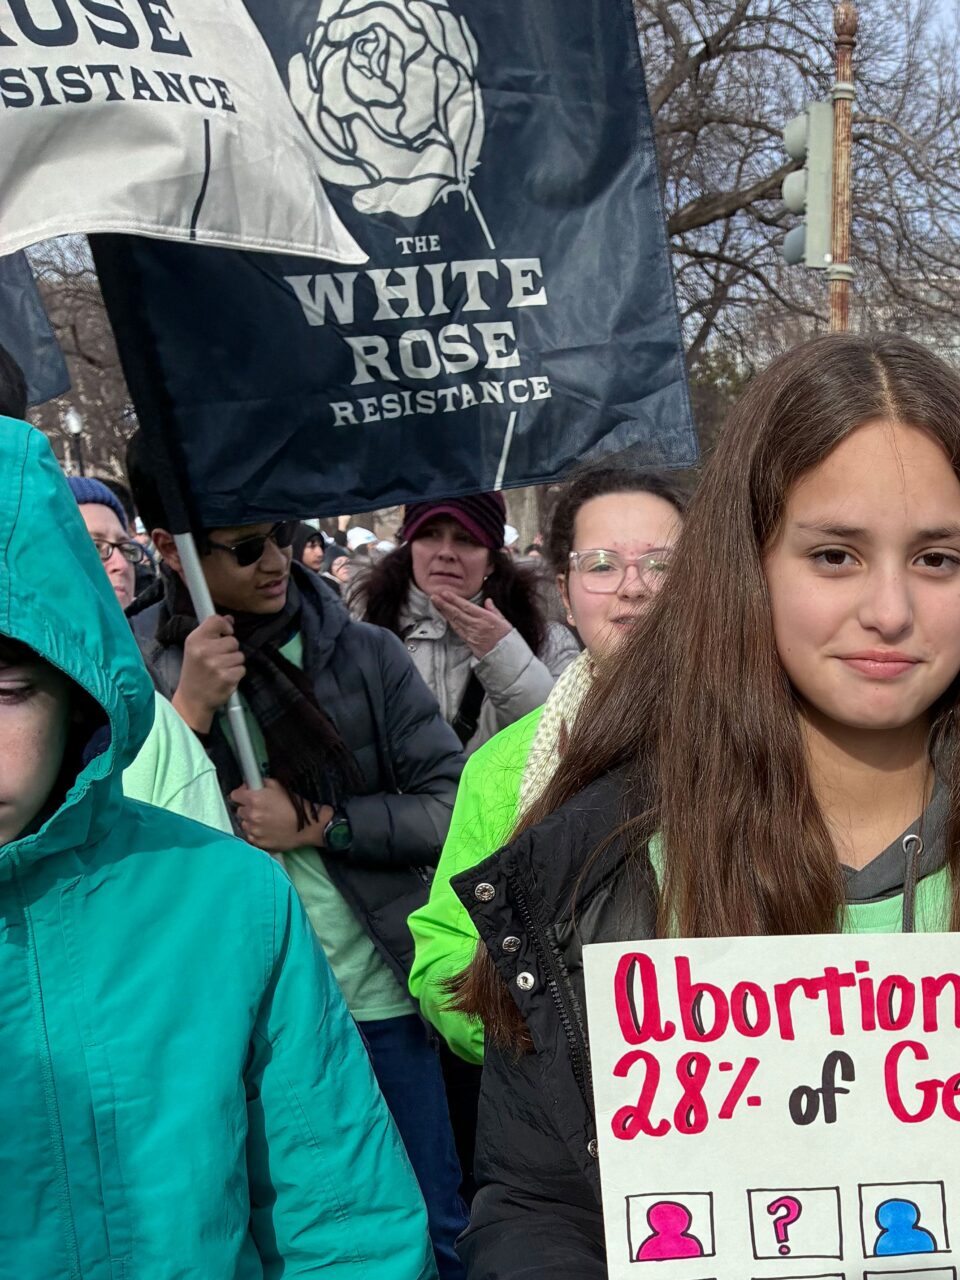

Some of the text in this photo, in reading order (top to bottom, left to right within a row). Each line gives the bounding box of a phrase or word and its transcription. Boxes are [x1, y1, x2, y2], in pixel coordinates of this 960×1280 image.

[0, 0, 192, 57] OSE
[396, 236, 441, 255] THE
[284, 257, 548, 327] WHITE
[350, 320, 521, 386] ROSE
[331, 376, 552, 427] RESISTANCE
[611, 1050, 762, 1140] 28%
[788, 1050, 855, 1125] of
